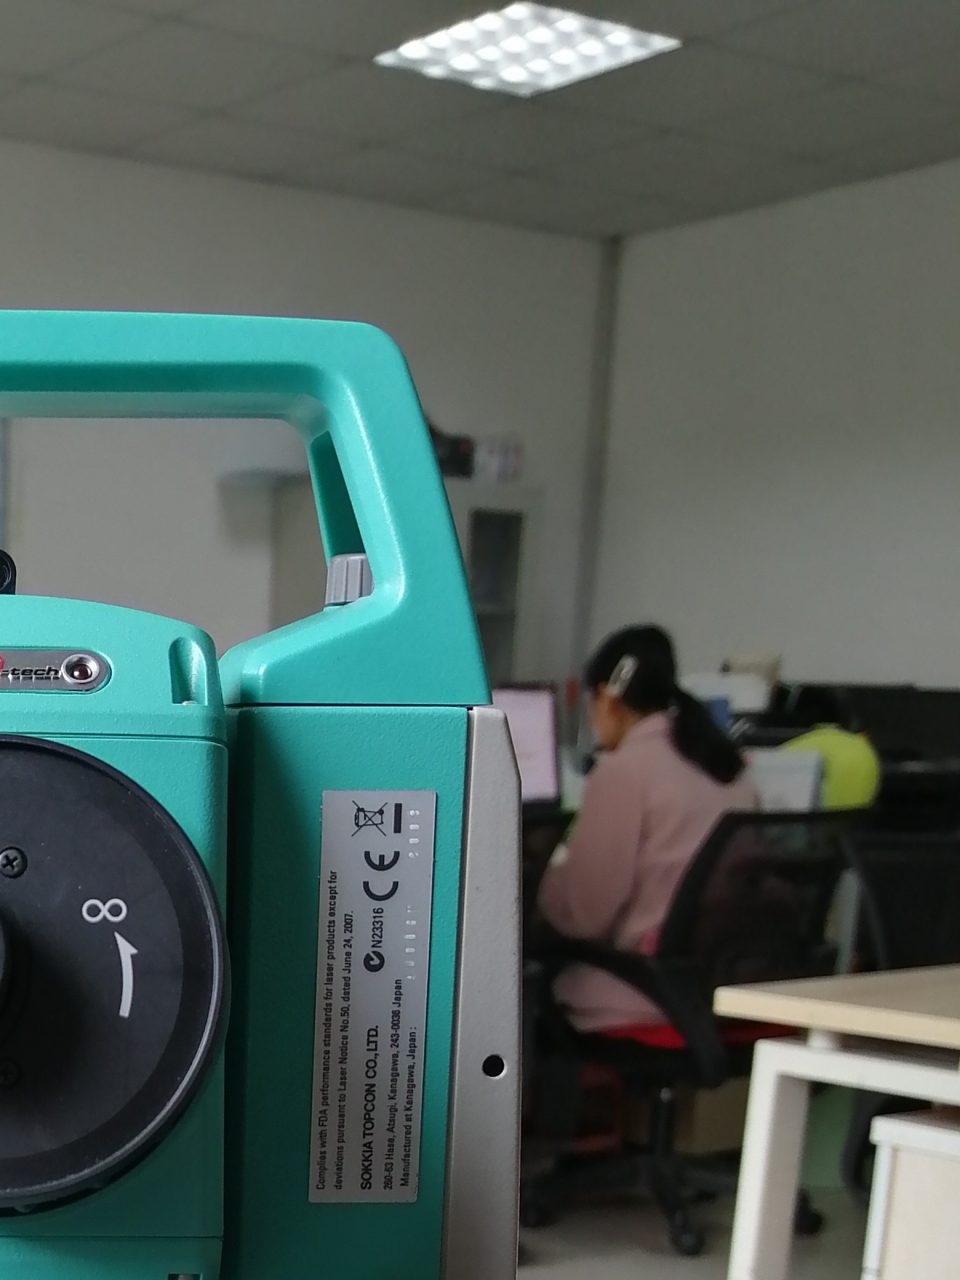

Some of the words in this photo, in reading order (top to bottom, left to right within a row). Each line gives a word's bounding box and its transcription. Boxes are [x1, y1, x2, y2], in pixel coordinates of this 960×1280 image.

[328, 871, 337, 883] for
[328, 886, 338, 917] except
[325, 920, 336, 960] products
[371, 908, 384, 948] N23316
[343, 936, 353, 949] 24,
[324, 963, 334, 985] laser
[342, 952, 352, 974] June
[323, 988, 333, 1000] for
[341, 976, 350, 1002] dated
[392, 979, 403, 1007] Japan
[322, 1003, 332, 1047] standards
[338, 1035, 348, 1064] Notice
[320, 1050, 331, 1106] performance
[338, 1068, 347, 1091] Laser
[338, 1094, 346, 1102] to
[363, 1084, 376, 1138] TOPCON
[318, 1109, 328, 1127] FDA
[336, 1104, 346, 1143] pursuant
[404, 1114, 412, 1122] at
[318, 1130, 328, 1148] with
[334, 1146, 344, 1190] deviations
[360, 1141, 373, 1190] SOKKIA
[400, 1125, 412, 1186] Manufactured
[316, 1151, 329, 1190] Complies
